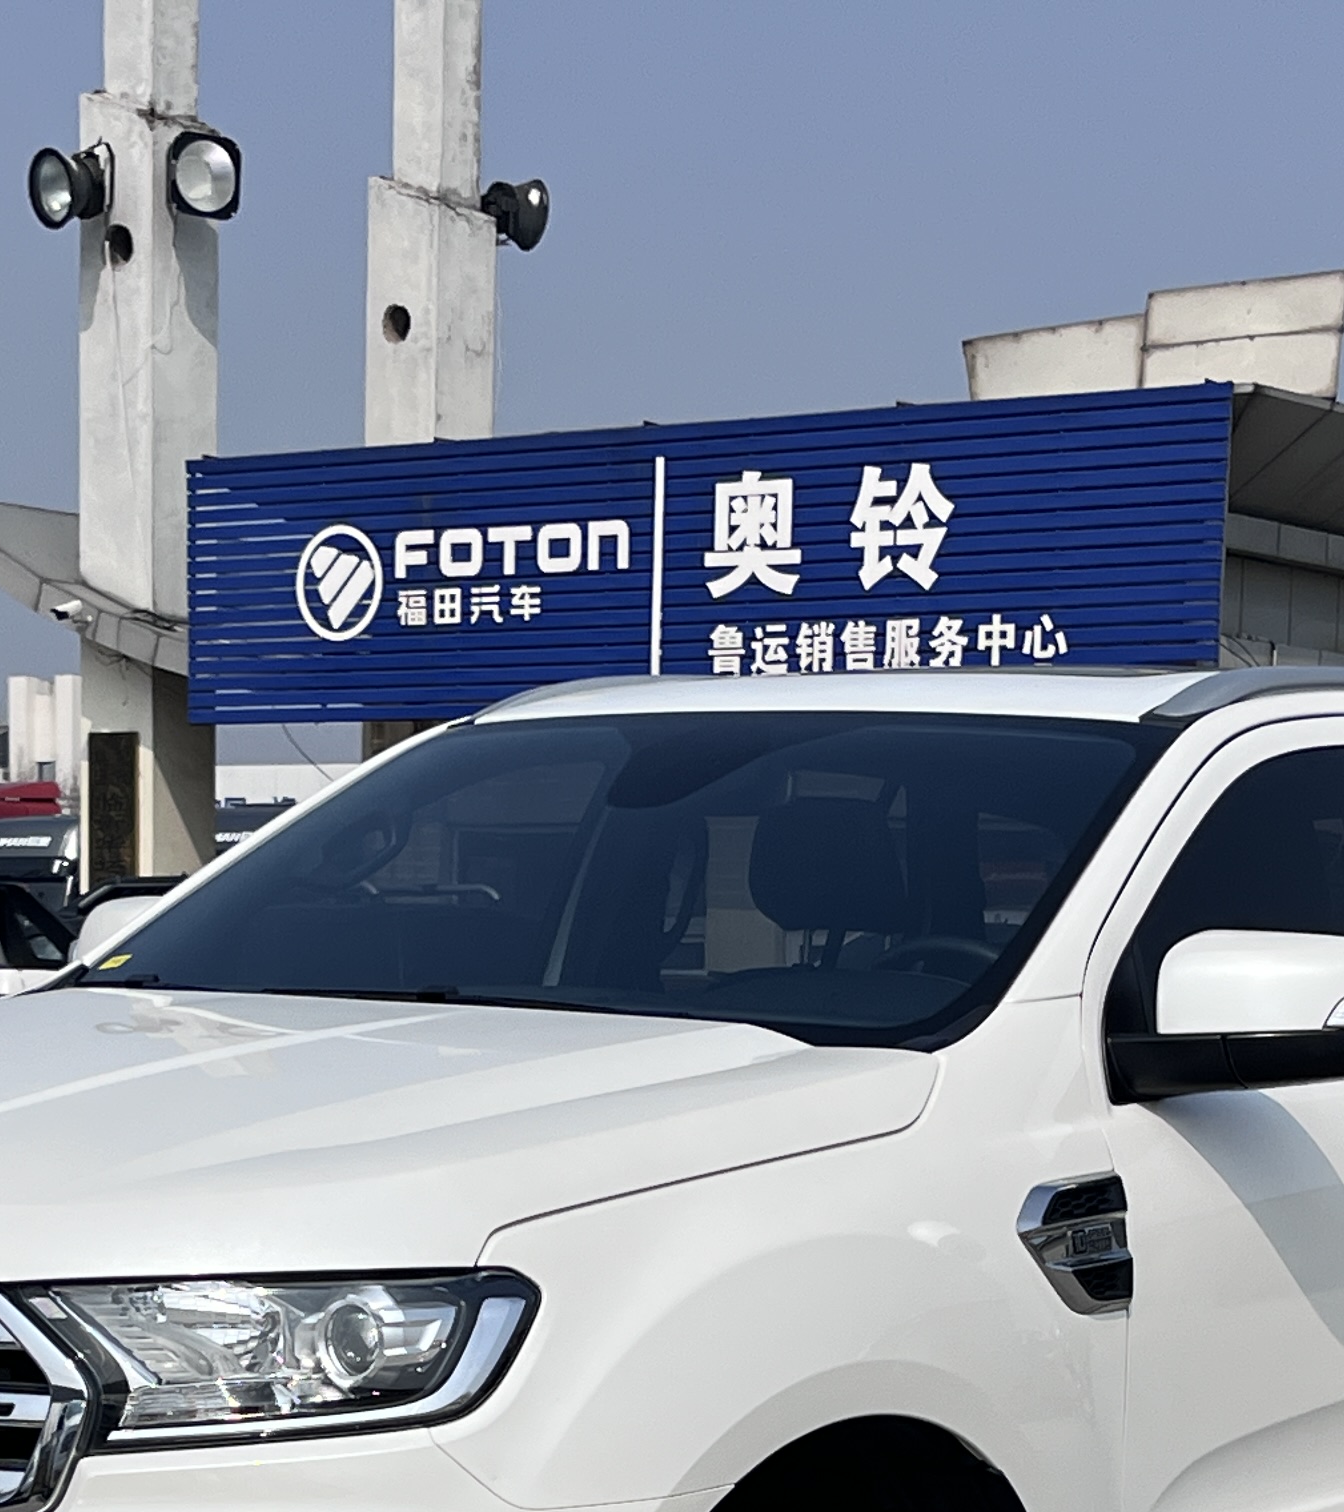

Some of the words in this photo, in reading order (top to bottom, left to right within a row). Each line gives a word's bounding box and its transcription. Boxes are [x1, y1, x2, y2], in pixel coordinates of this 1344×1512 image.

[393, 519, 631, 580] FOTON
[703, 462, 956, 599] 奥铃
[397, 584, 543, 626] 福田汽车
[708, 613, 1069, 678] 鲁运销售服务中心
